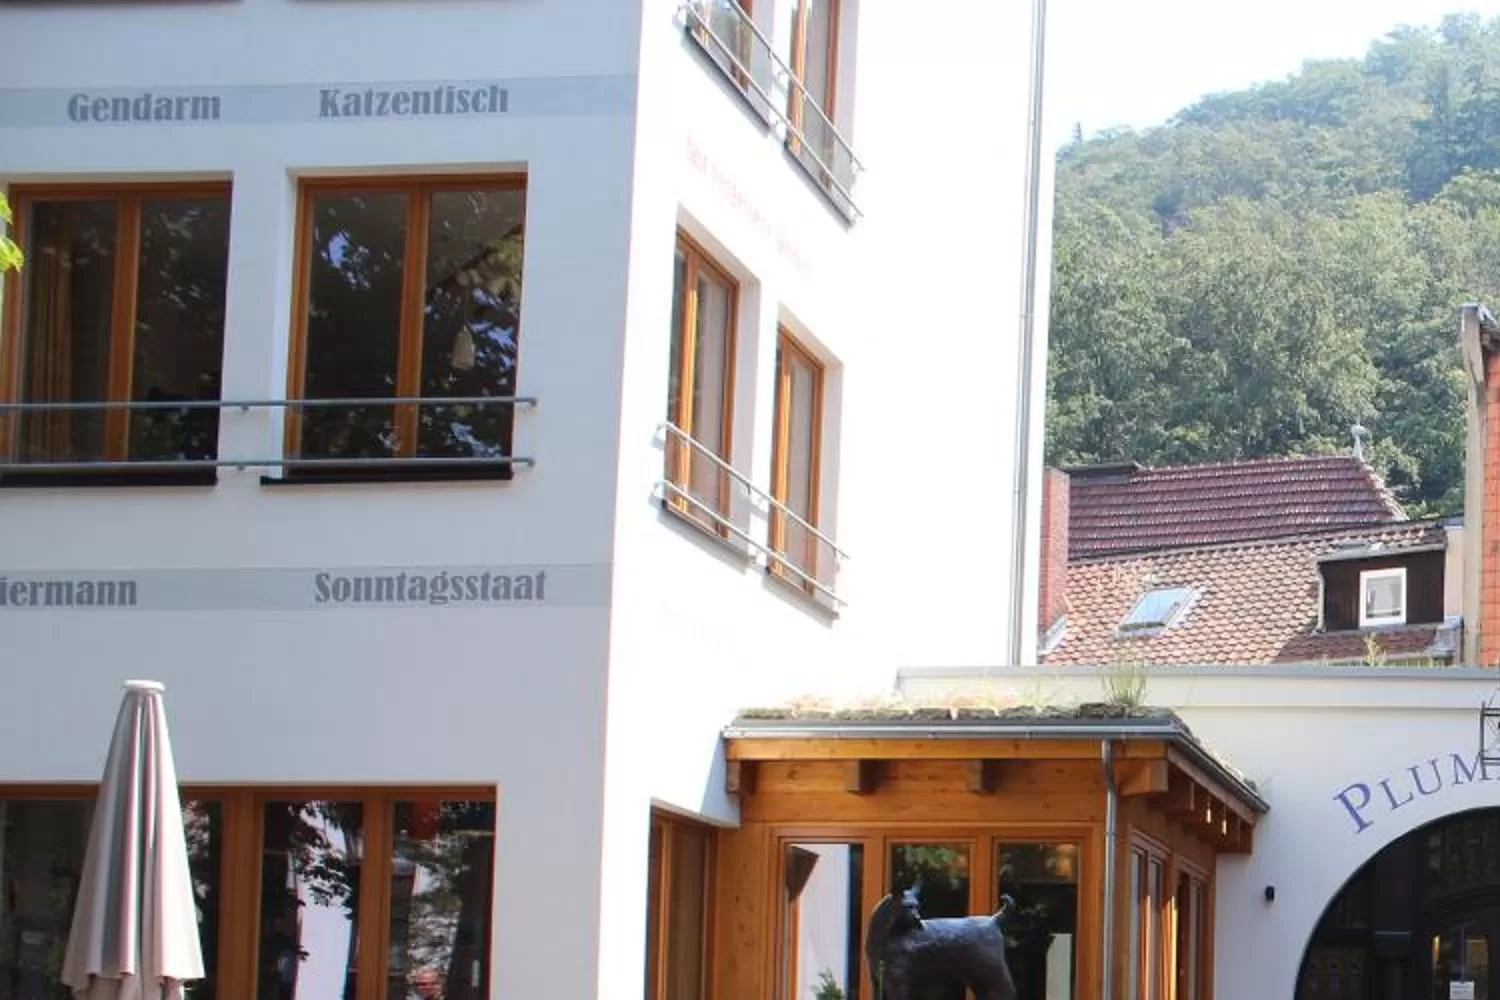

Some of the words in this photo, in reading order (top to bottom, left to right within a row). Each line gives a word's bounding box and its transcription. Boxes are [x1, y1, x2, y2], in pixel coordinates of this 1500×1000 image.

[67, 92, 221, 122] Gendarm
[319, 86, 509, 117] Katzentisch
[315, 570, 546, 605] Sonntagsstaat
